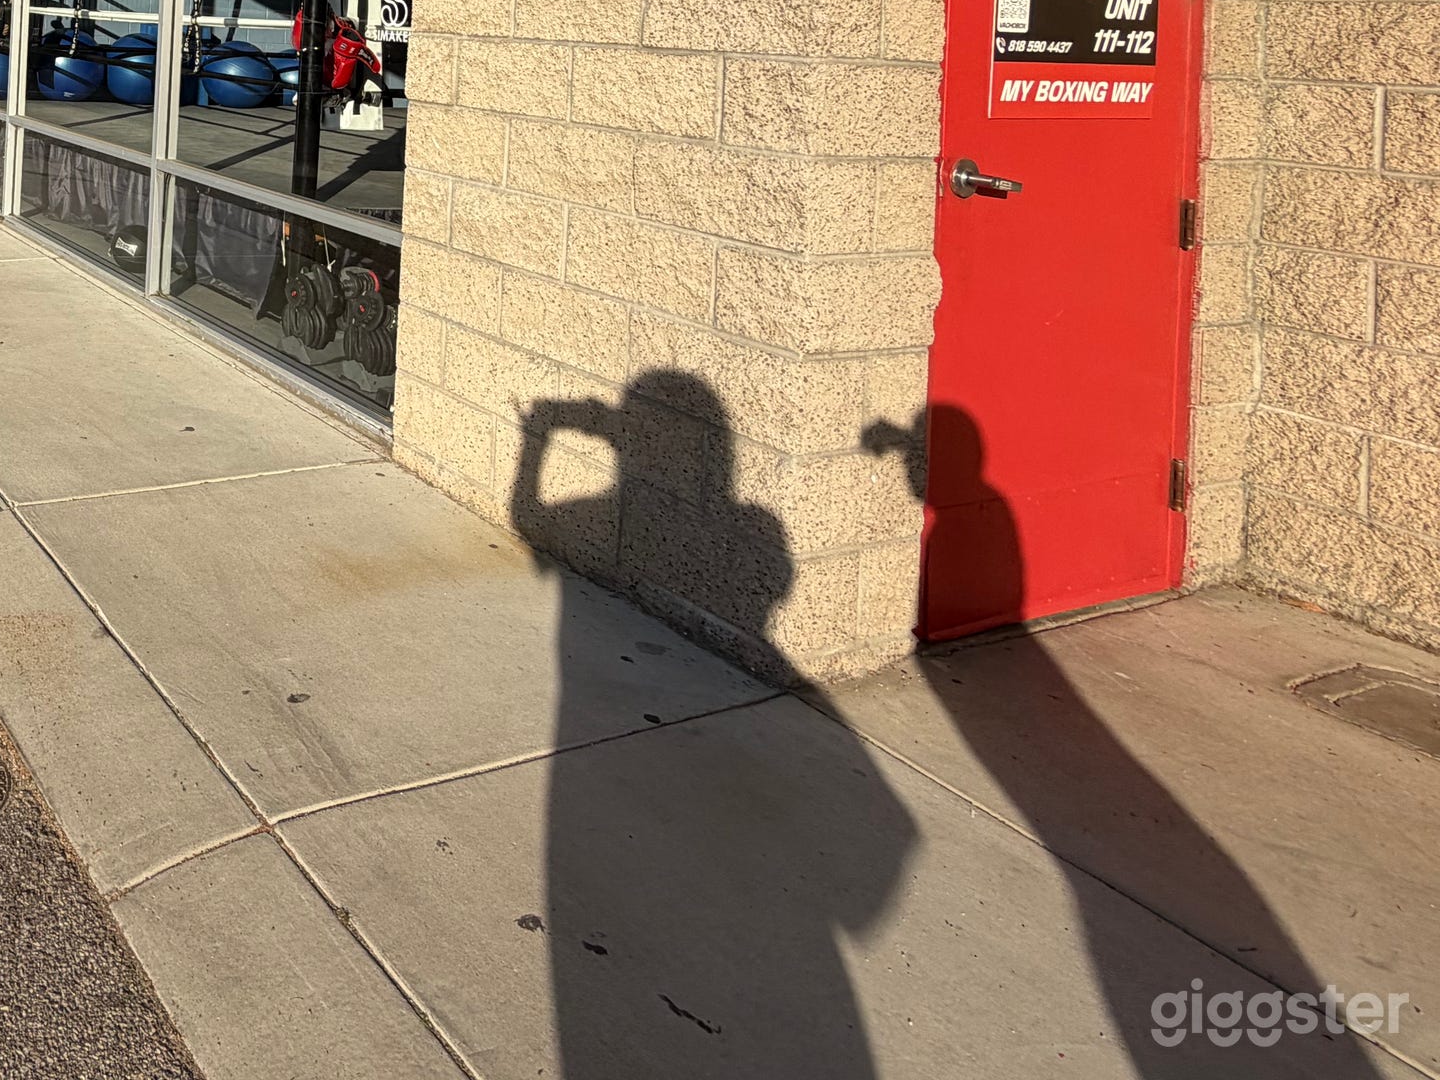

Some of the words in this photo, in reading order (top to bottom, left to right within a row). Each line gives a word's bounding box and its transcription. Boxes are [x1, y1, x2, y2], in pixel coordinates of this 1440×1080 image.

[373, 30, 410, 43] SIMAKE
[1093, 28, 1155, 54] 111-112
[1008, 39, 1026, 52] 818
[1026, 40, 1047, 53] 590
[1047, 41, 1073, 54] 4437
[1000, 80, 1035, 102] MY
[1035, 80, 1109, 103] BOXING
[1111, 82, 1154, 103] WAY
